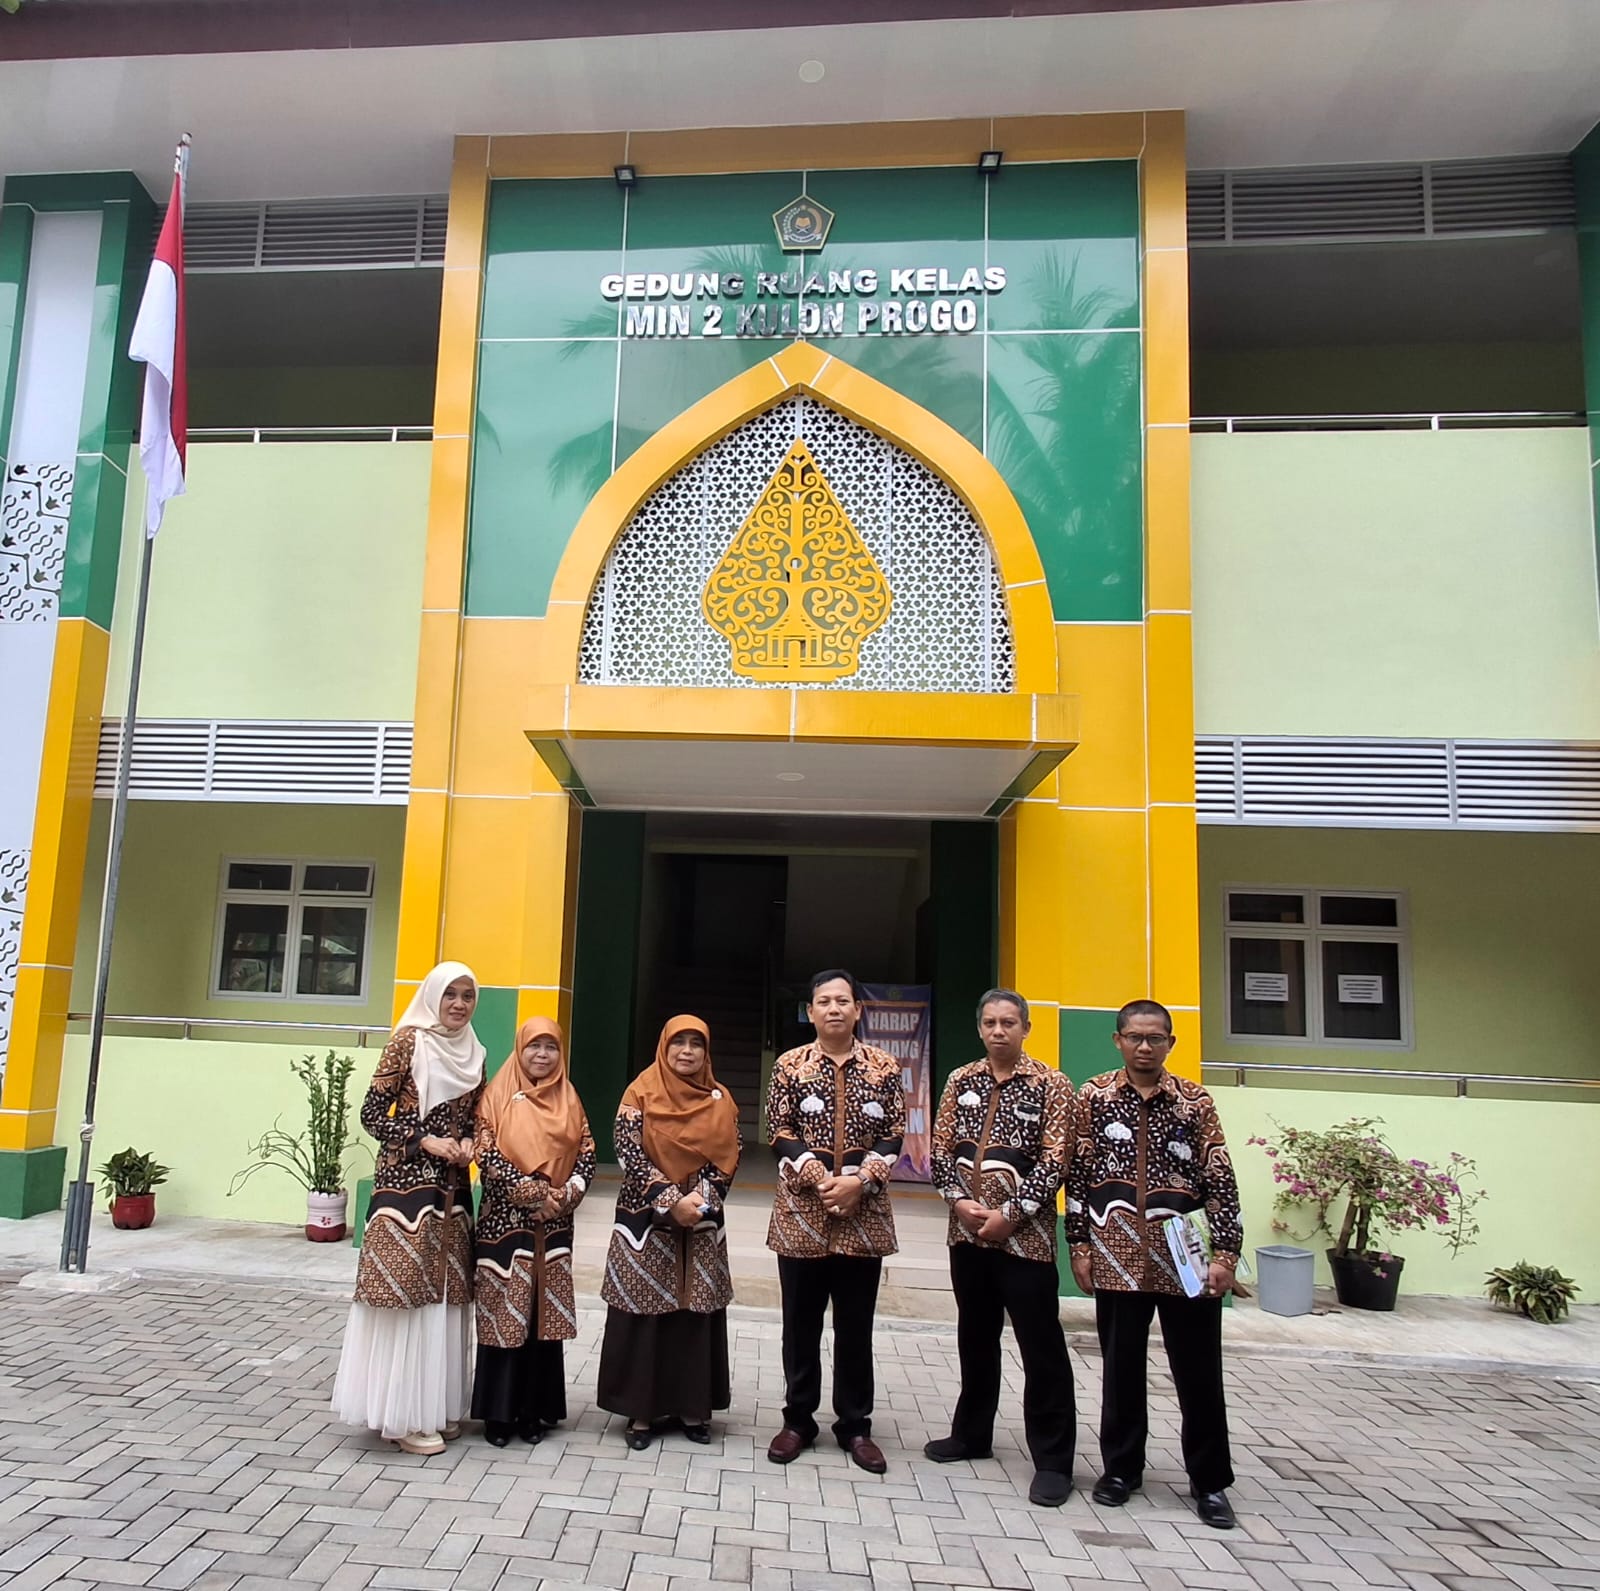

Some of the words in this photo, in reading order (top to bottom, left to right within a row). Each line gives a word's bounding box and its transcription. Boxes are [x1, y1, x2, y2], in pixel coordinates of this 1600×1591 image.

[600, 272, 745, 299] GEDUNG
[757, 269, 878, 296] RUANG
[890, 266, 1008, 294] KELAS
[626, 304, 691, 336] MIN
[702, 304, 723, 336] 2
[735, 302, 845, 336] KULON
[858, 299, 977, 333] PROGO
[868, 1011, 920, 1031] HARAP
[863, 1039, 920, 1059] NANG
